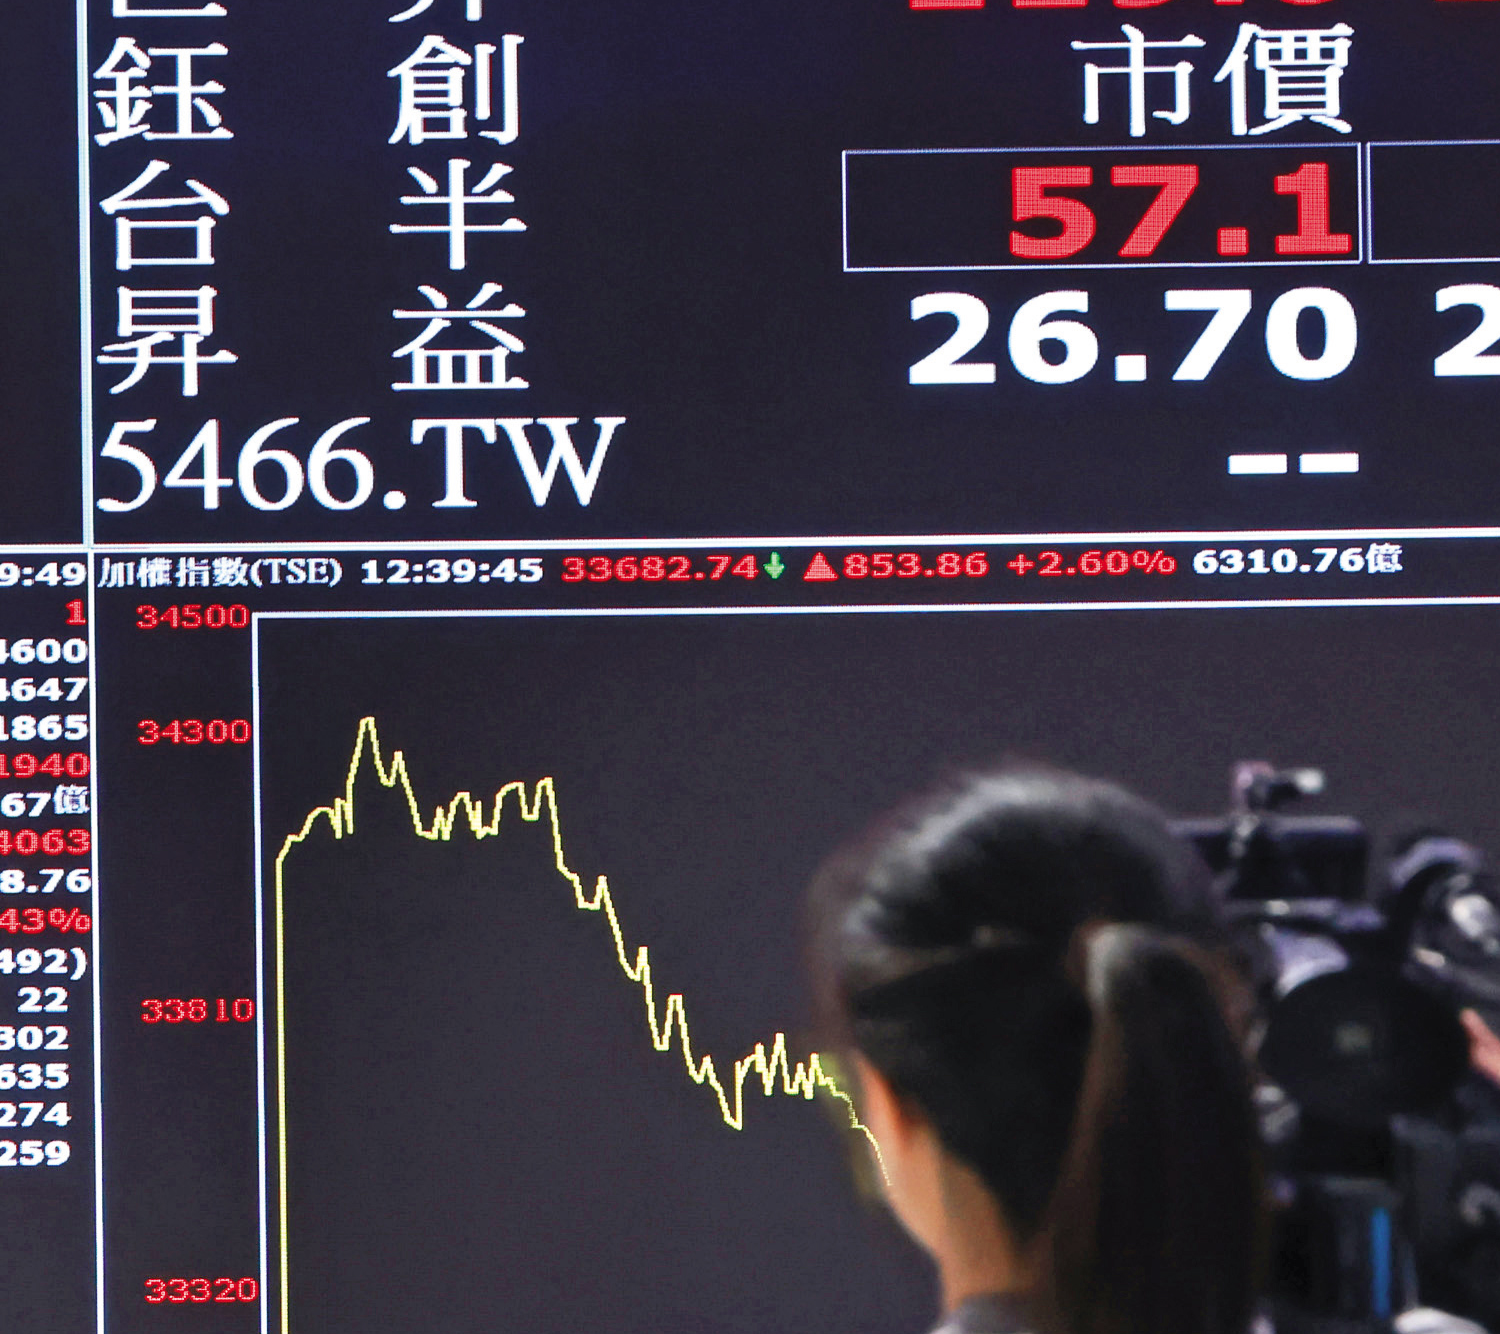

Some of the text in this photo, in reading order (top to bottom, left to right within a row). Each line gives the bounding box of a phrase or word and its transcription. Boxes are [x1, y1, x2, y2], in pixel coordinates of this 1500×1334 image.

[1071, 23, 1354, 136] 市價
[910, 287, 1357, 383] 26.70
[97, 417, 626, 511] 5466.TW
[362, 558, 543, 583] 12:39:45
[562, 555, 759, 582] 33682.74
[843, 552, 989, 578] 853.86
[1007, 550, 1177, 576] +2.60%
[1194, 543, 1402, 573] 6310.76億
[137, 604, 249, 628] 34500
[138, 720, 251, 744] 34300
[141, 999, 254, 1023] 33810
[144, 1277, 259, 1303] 33320
